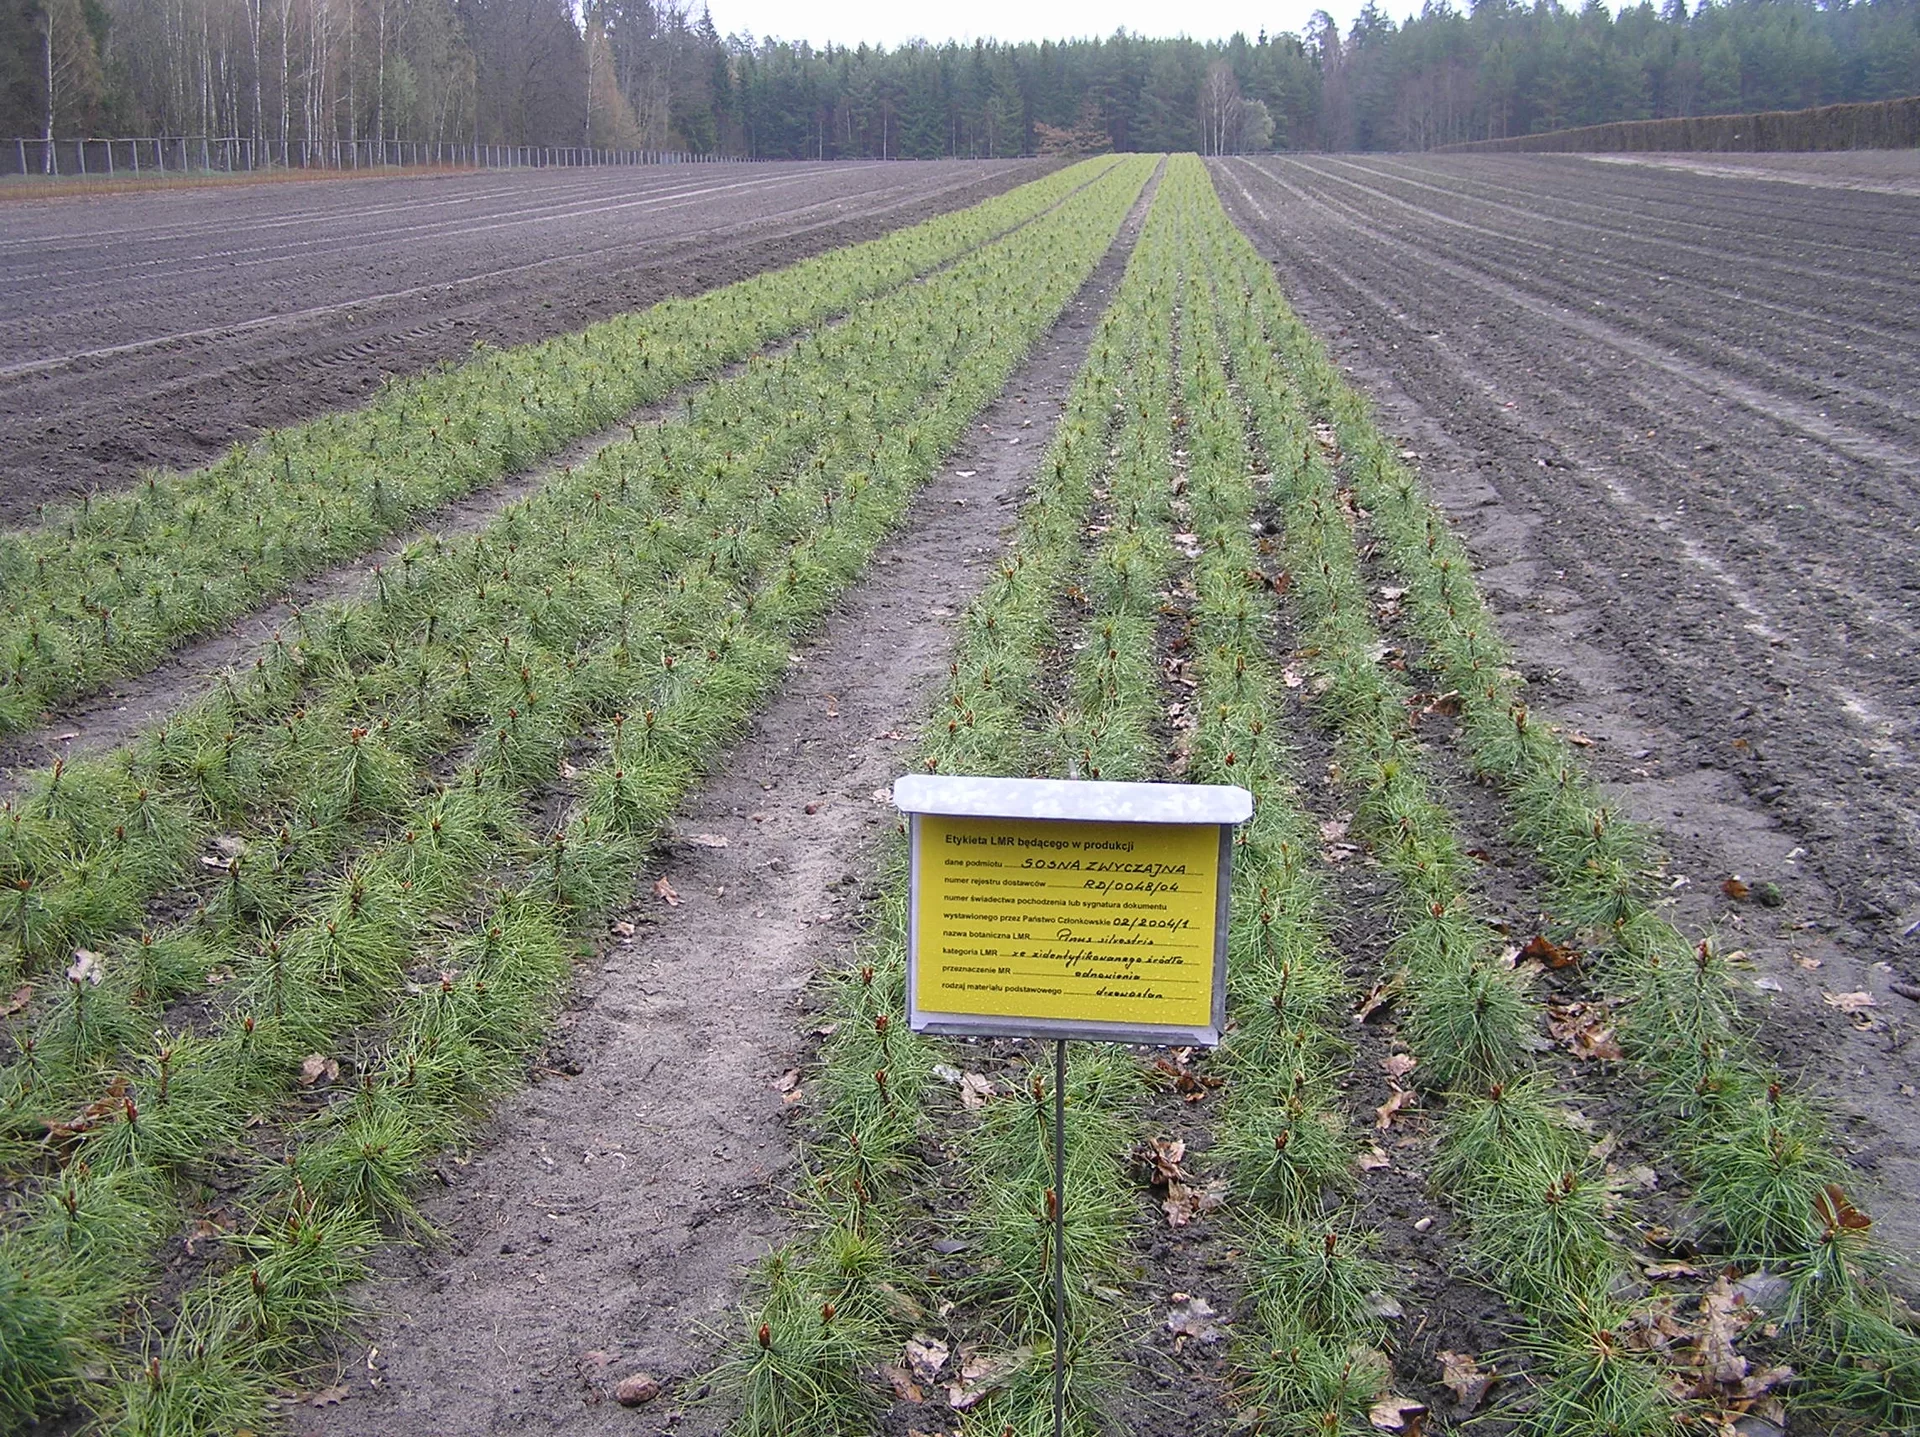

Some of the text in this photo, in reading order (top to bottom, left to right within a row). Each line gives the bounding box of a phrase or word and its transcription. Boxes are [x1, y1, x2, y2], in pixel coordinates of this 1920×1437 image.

[945, 834, 987, 846] Etykieta
[991, 837, 1014, 846] LMR
[1018, 838, 1069, 850] będącego
[1084, 841, 1134, 852] produkcji
[966, 860, 1002, 868] podmiotu
[1021, 859, 1080, 870] SOSNA
[1086, 861, 1186, 877] ZWYCZAJNA
[971, 878, 1000, 886] rejestru
[1084, 880, 1179, 896] RD/0048/04
[971, 895, 1015, 904] świadectwa
[1018, 897, 1066, 907] pochodzenia
[1083, 901, 1120, 909] sygnatura
[1123, 902, 1167, 911] dokumentu
[944, 913, 1189, 933] wystawionego przez Państwo Członkowskie 02/2004/1
[969, 931, 1010, 939] botaniczna
[1057, 928, 1092, 943] Pinus
[942, 965, 996, 974] przeznaczenie
[942, 982, 965, 990] rodzaj
[967, 984, 1002, 992] materiału
[1005, 986, 1062, 995] podstawowego
